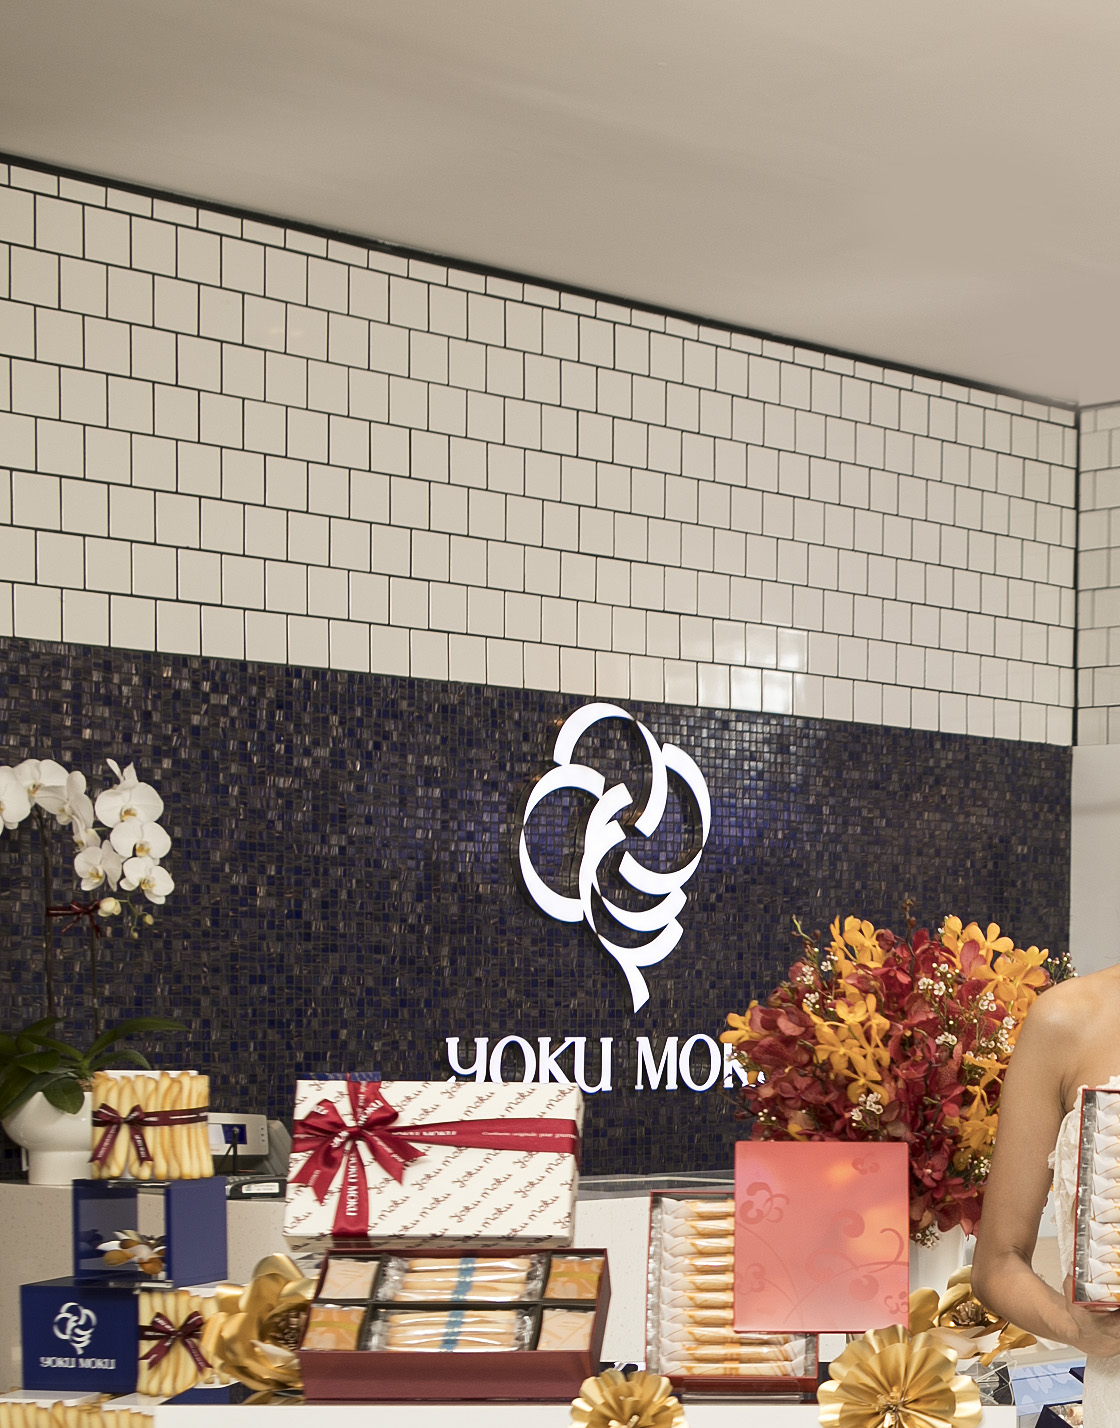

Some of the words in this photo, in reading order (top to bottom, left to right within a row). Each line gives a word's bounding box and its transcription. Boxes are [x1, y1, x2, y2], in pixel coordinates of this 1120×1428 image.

[446, 1035, 613, 1094] YOKU
[634, 1033, 767, 1092] MOK
[39, 1356, 76, 1368] YOKU
[78, 1358, 116, 1370] MOKU
